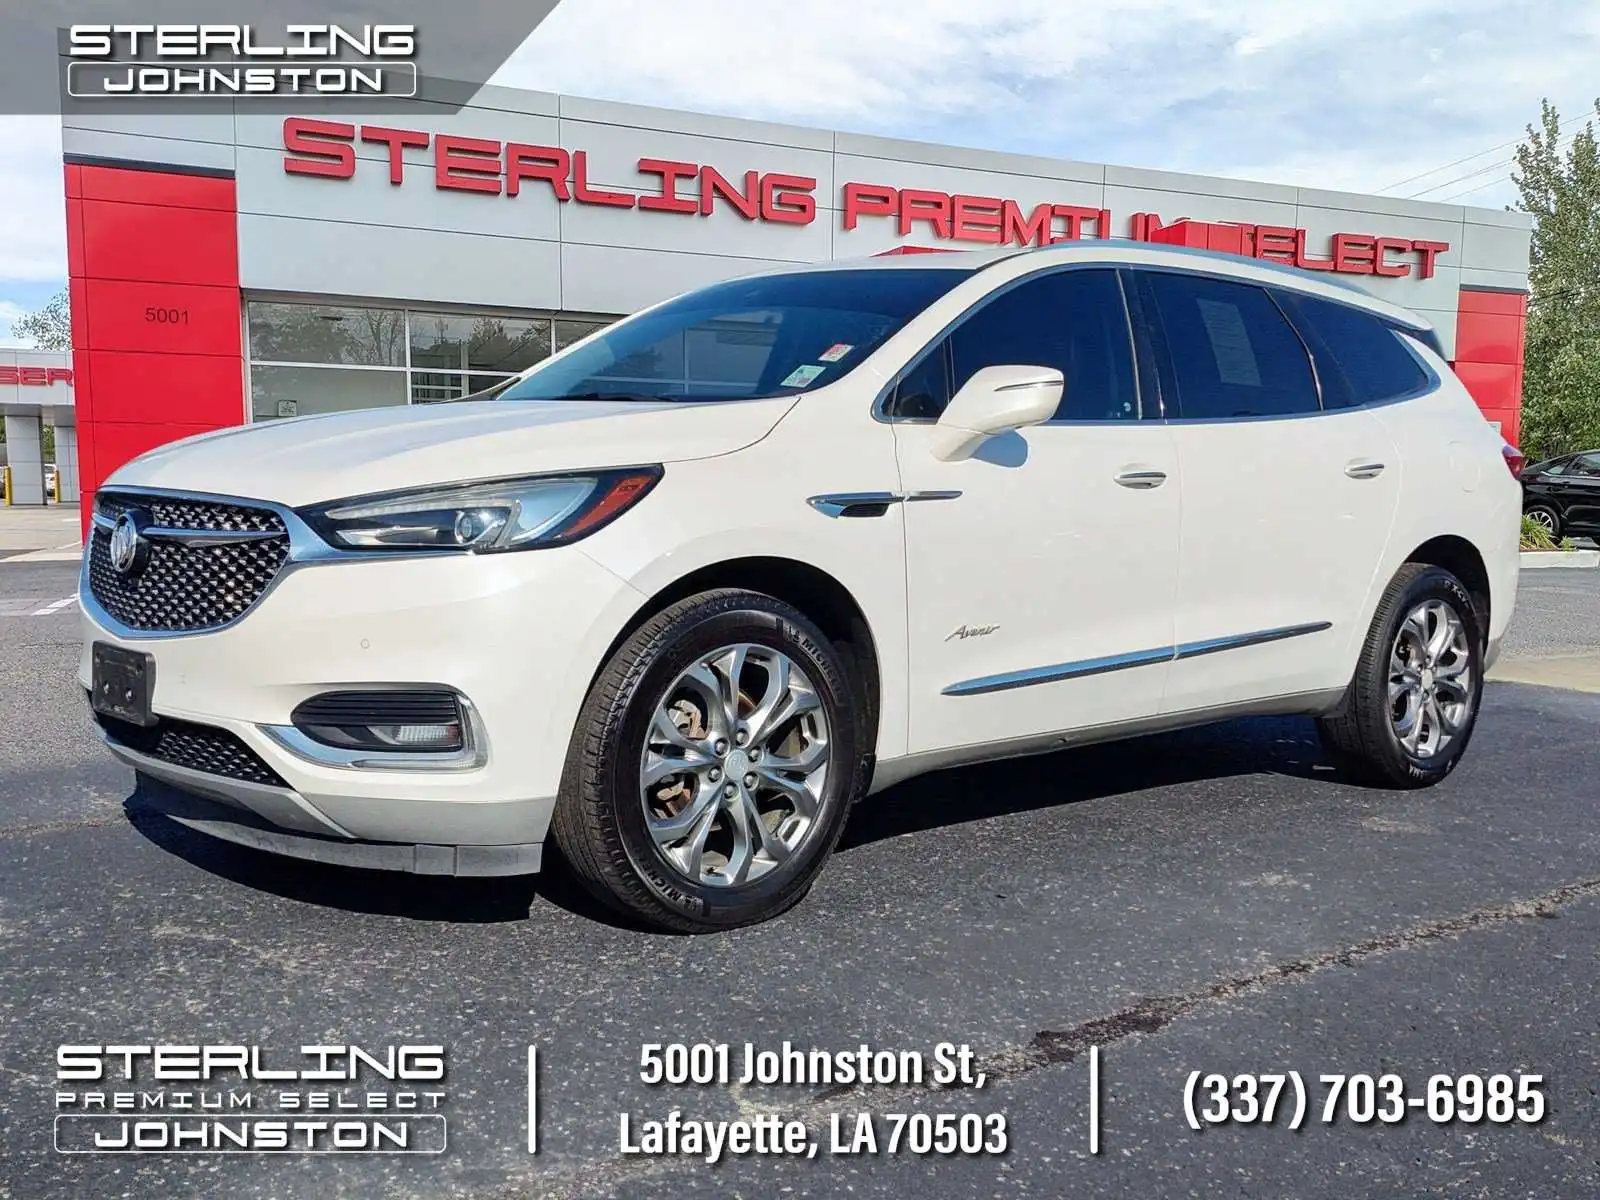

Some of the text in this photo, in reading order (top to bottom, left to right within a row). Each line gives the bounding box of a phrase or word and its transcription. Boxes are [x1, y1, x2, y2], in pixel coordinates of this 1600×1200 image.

[283, 116, 817, 225] STERLING
[1217, 220, 1450, 280] ELECT
[145, 308, 190, 324] 5001
